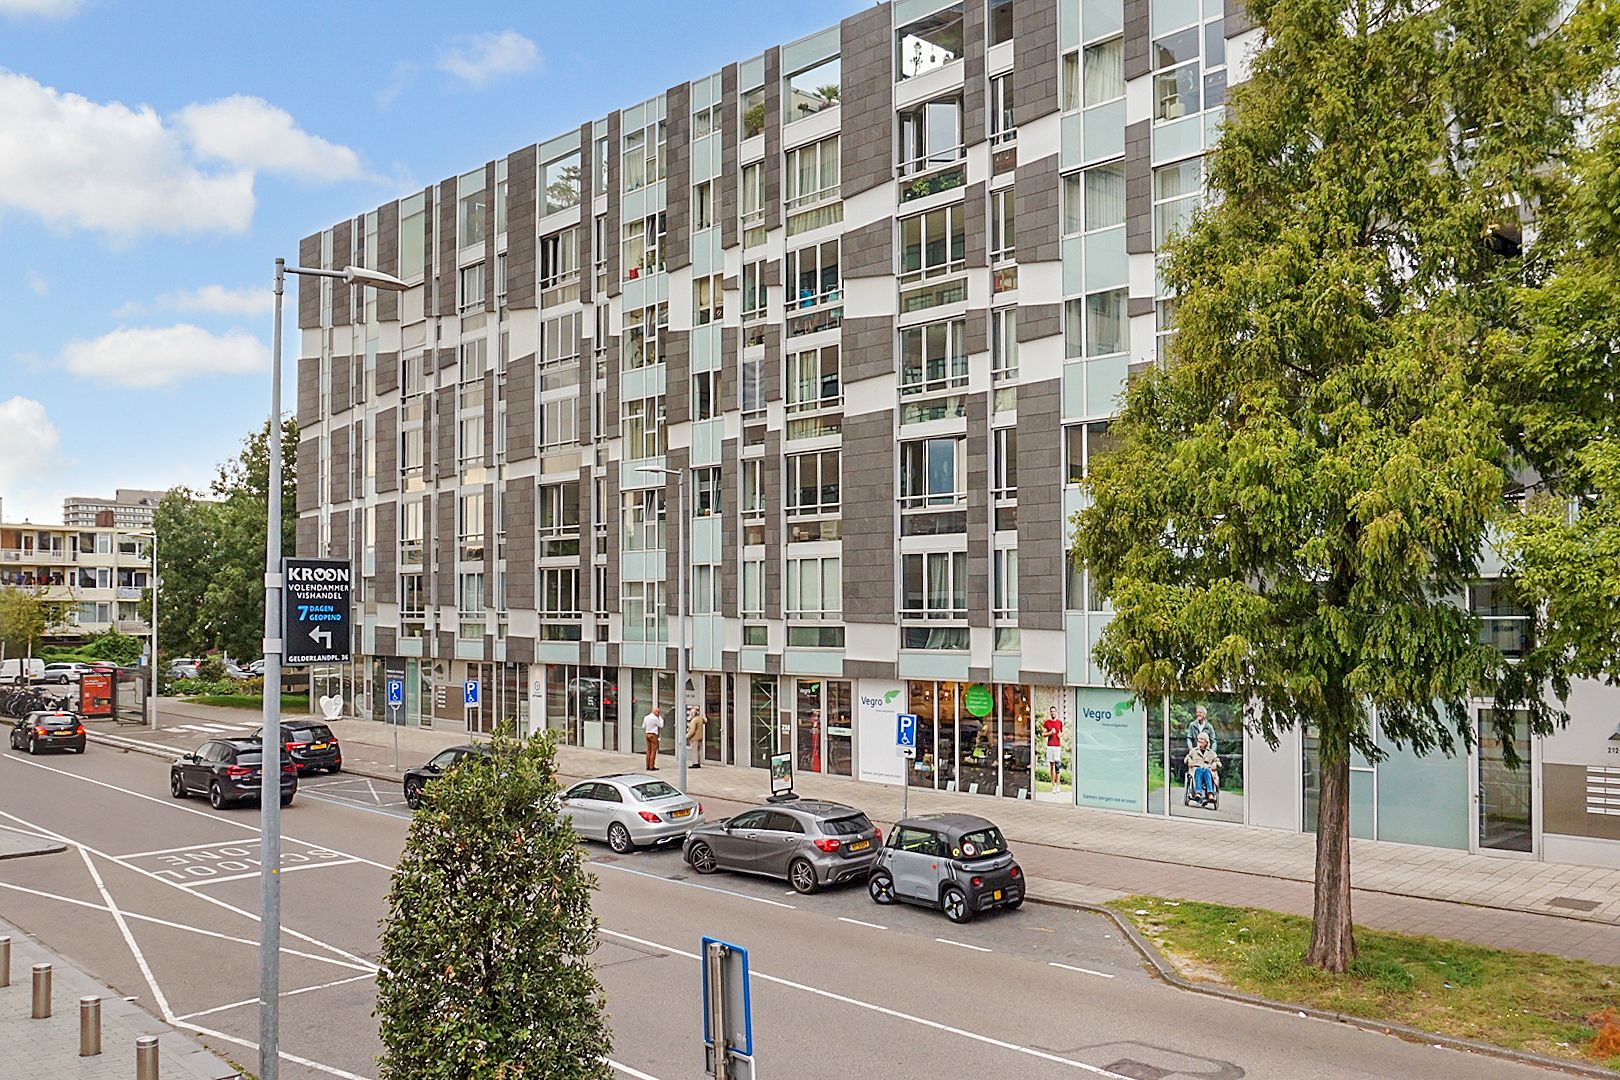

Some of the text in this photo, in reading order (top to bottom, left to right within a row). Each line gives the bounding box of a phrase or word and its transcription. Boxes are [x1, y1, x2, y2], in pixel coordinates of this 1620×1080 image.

[288, 567, 349, 581] KROON
[297, 605, 308, 621] 7
[391, 683, 399, 693] P
[467, 683, 475, 694] P
[861, 696, 883, 708] Vegro
[1083, 707, 1112, 721] Vegro
[900, 717, 912, 733] P
